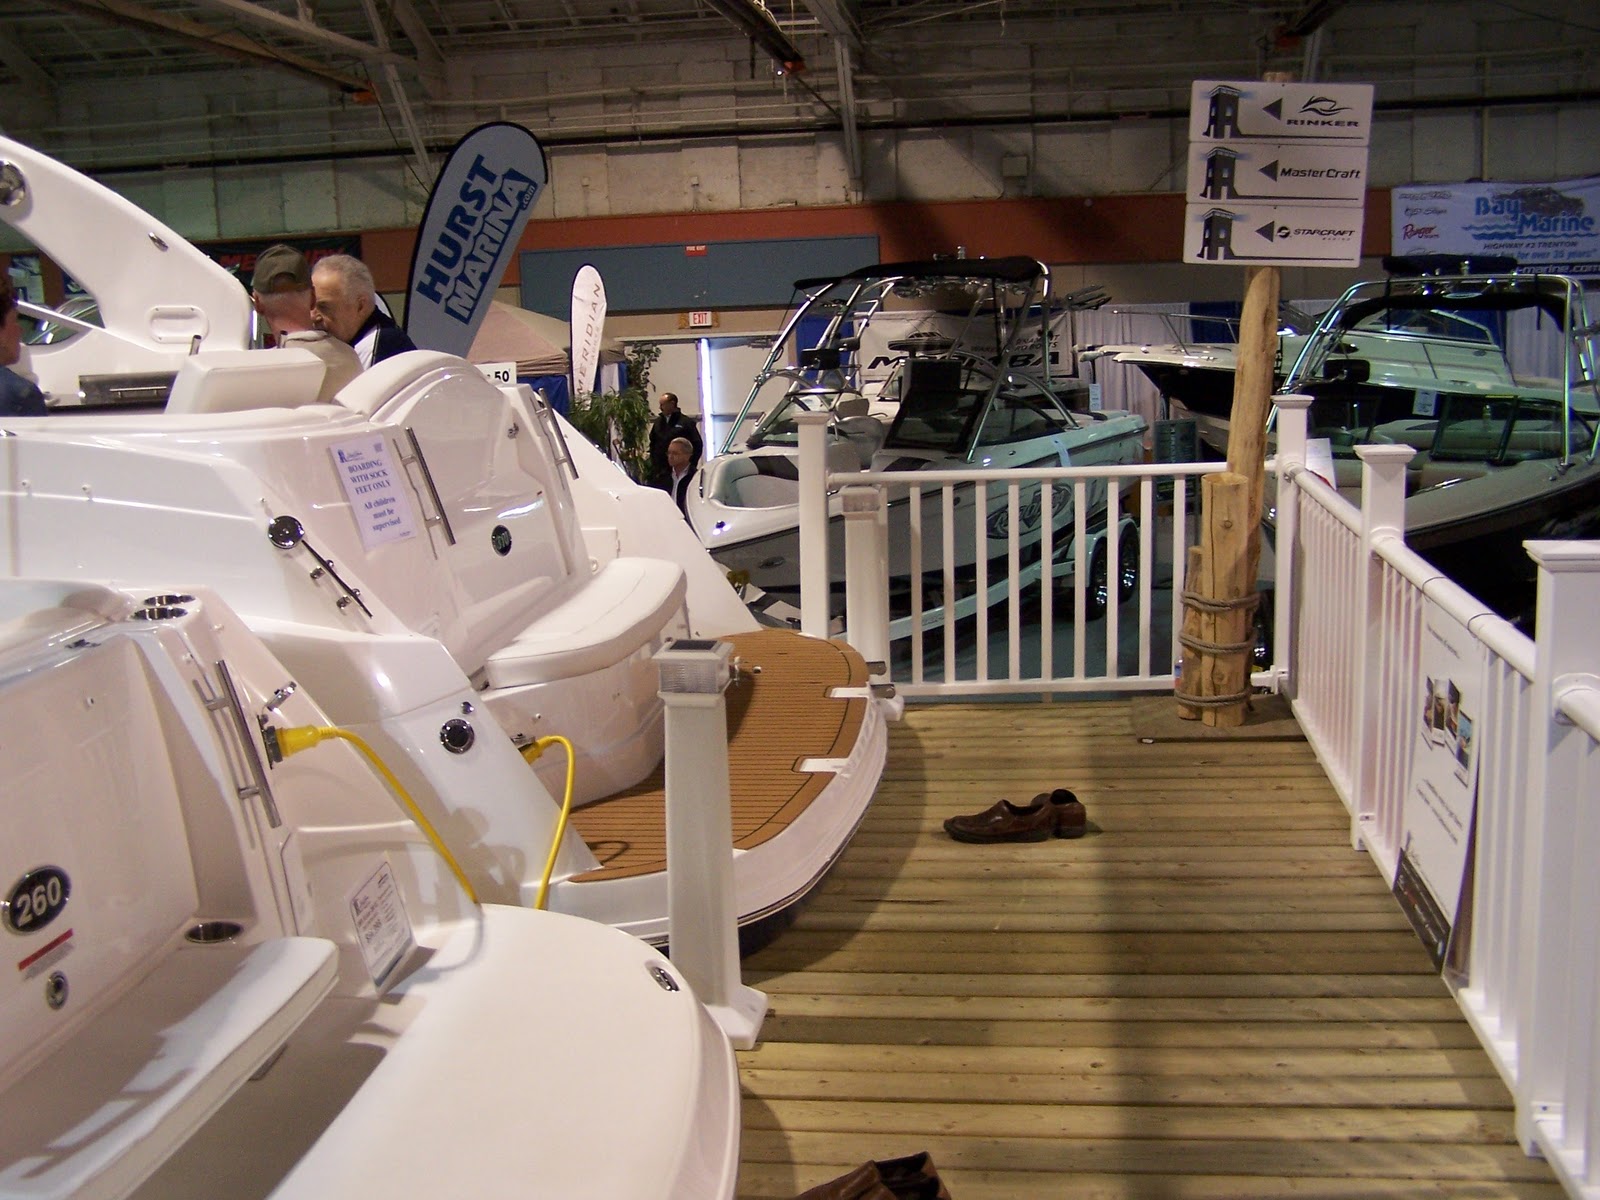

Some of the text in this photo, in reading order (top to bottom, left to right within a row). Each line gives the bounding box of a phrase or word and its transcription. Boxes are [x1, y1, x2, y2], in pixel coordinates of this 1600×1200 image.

[1286, 119, 1359, 128] RINKER
[1280, 167, 1361, 179] MasterCraft
[522, 186, 536, 209] .com
[1475, 197, 1520, 221] Bay
[416, 154, 497, 304] HURST
[1517, 210, 1595, 235] Marine
[1293, 228, 1355, 237] STARCRAFT
[446, 174, 532, 320] MARINA
[1483, 242, 1524, 250] HIGHWAY
[1538, 241, 1578, 249] TRENTON
[693, 313, 707, 324] EXIT
[576, 283, 601, 394] MERIDIAN
[348, 460, 382, 473] BOARDING
[350, 469, 388, 483] WITH SOCK
[355, 480, 391, 495] FEET ONLY
[373, 497, 396, 508] children
[373, 510, 387, 519] must
[372, 517, 401, 531] supervised
[17, 876, 61, 927] 260
